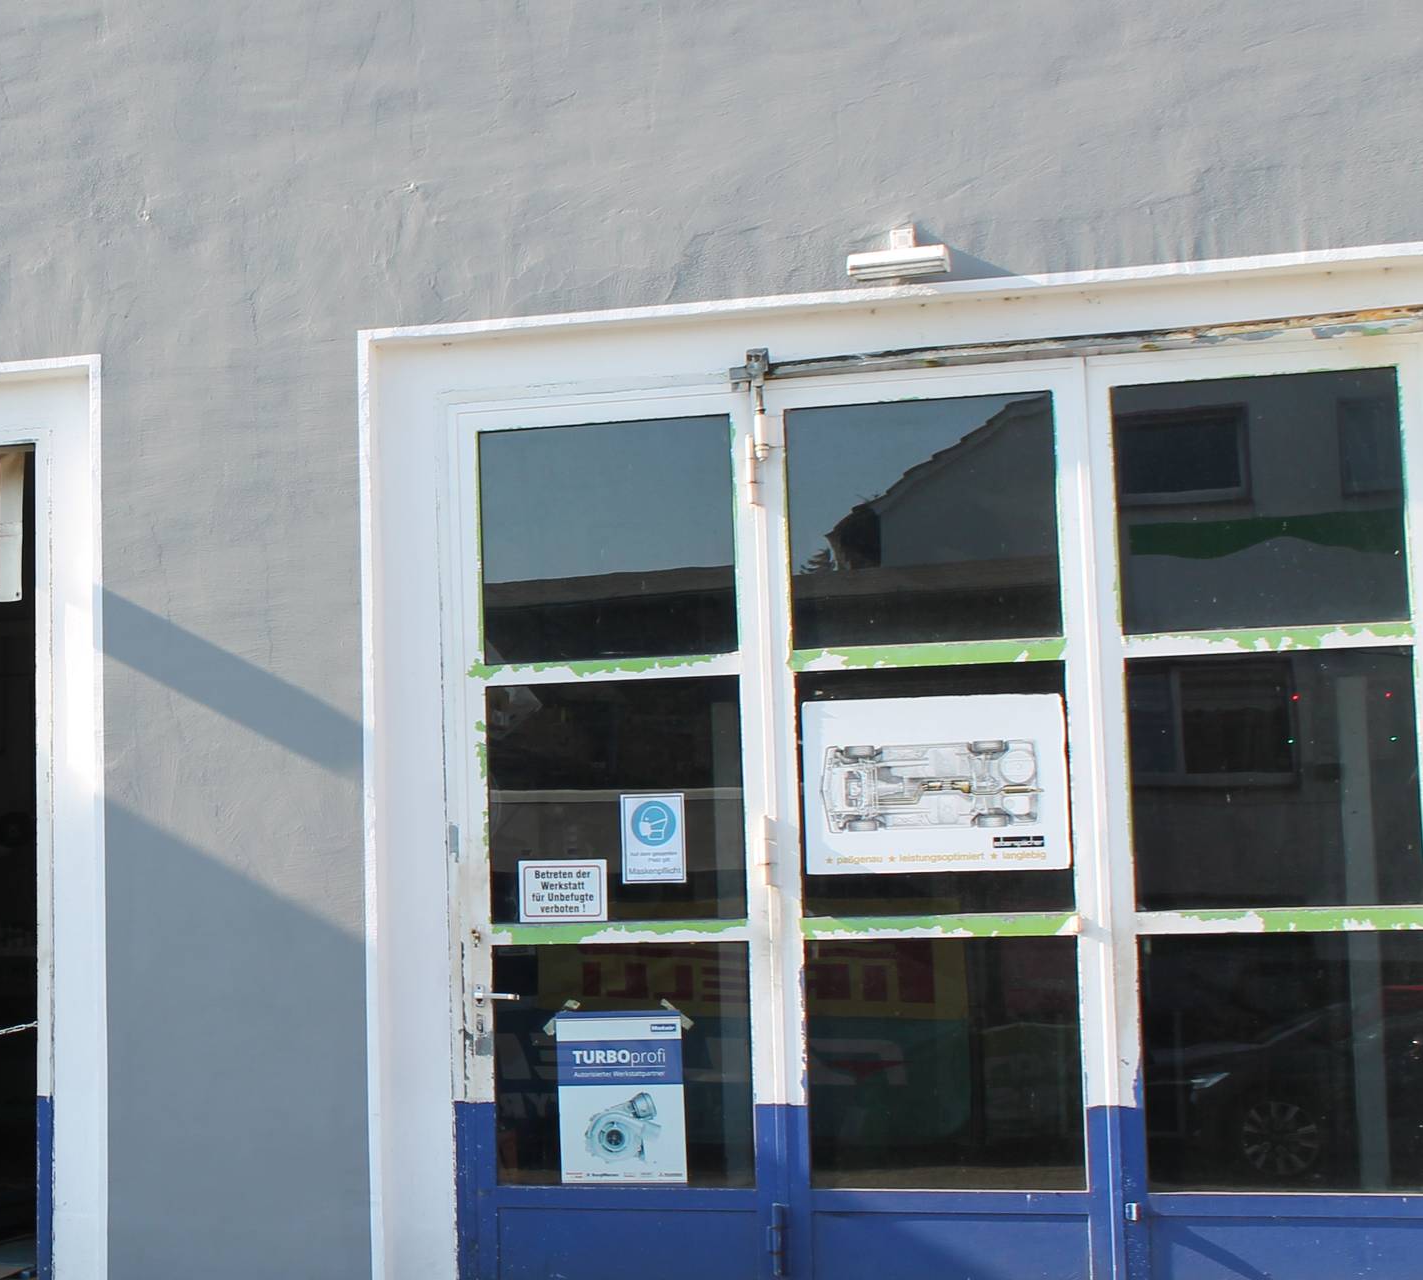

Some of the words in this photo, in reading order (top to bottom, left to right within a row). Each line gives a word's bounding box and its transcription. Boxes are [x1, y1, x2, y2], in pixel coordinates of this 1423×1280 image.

[899, 852, 984, 863] leistungsoptimiert
[1002, 850, 1046, 860] langlebig
[535, 871, 573, 879] Betreten
[576, 870, 591, 878] der
[629, 866, 681, 875] Maskenpflicht
[541, 882, 585, 890] Werkstatt
[532, 893, 545, 902] für
[548, 893, 594, 903] Unbefugte
[540, 904, 580, 913] verboten
[572, 1048, 665, 1067] TURBOprofi
